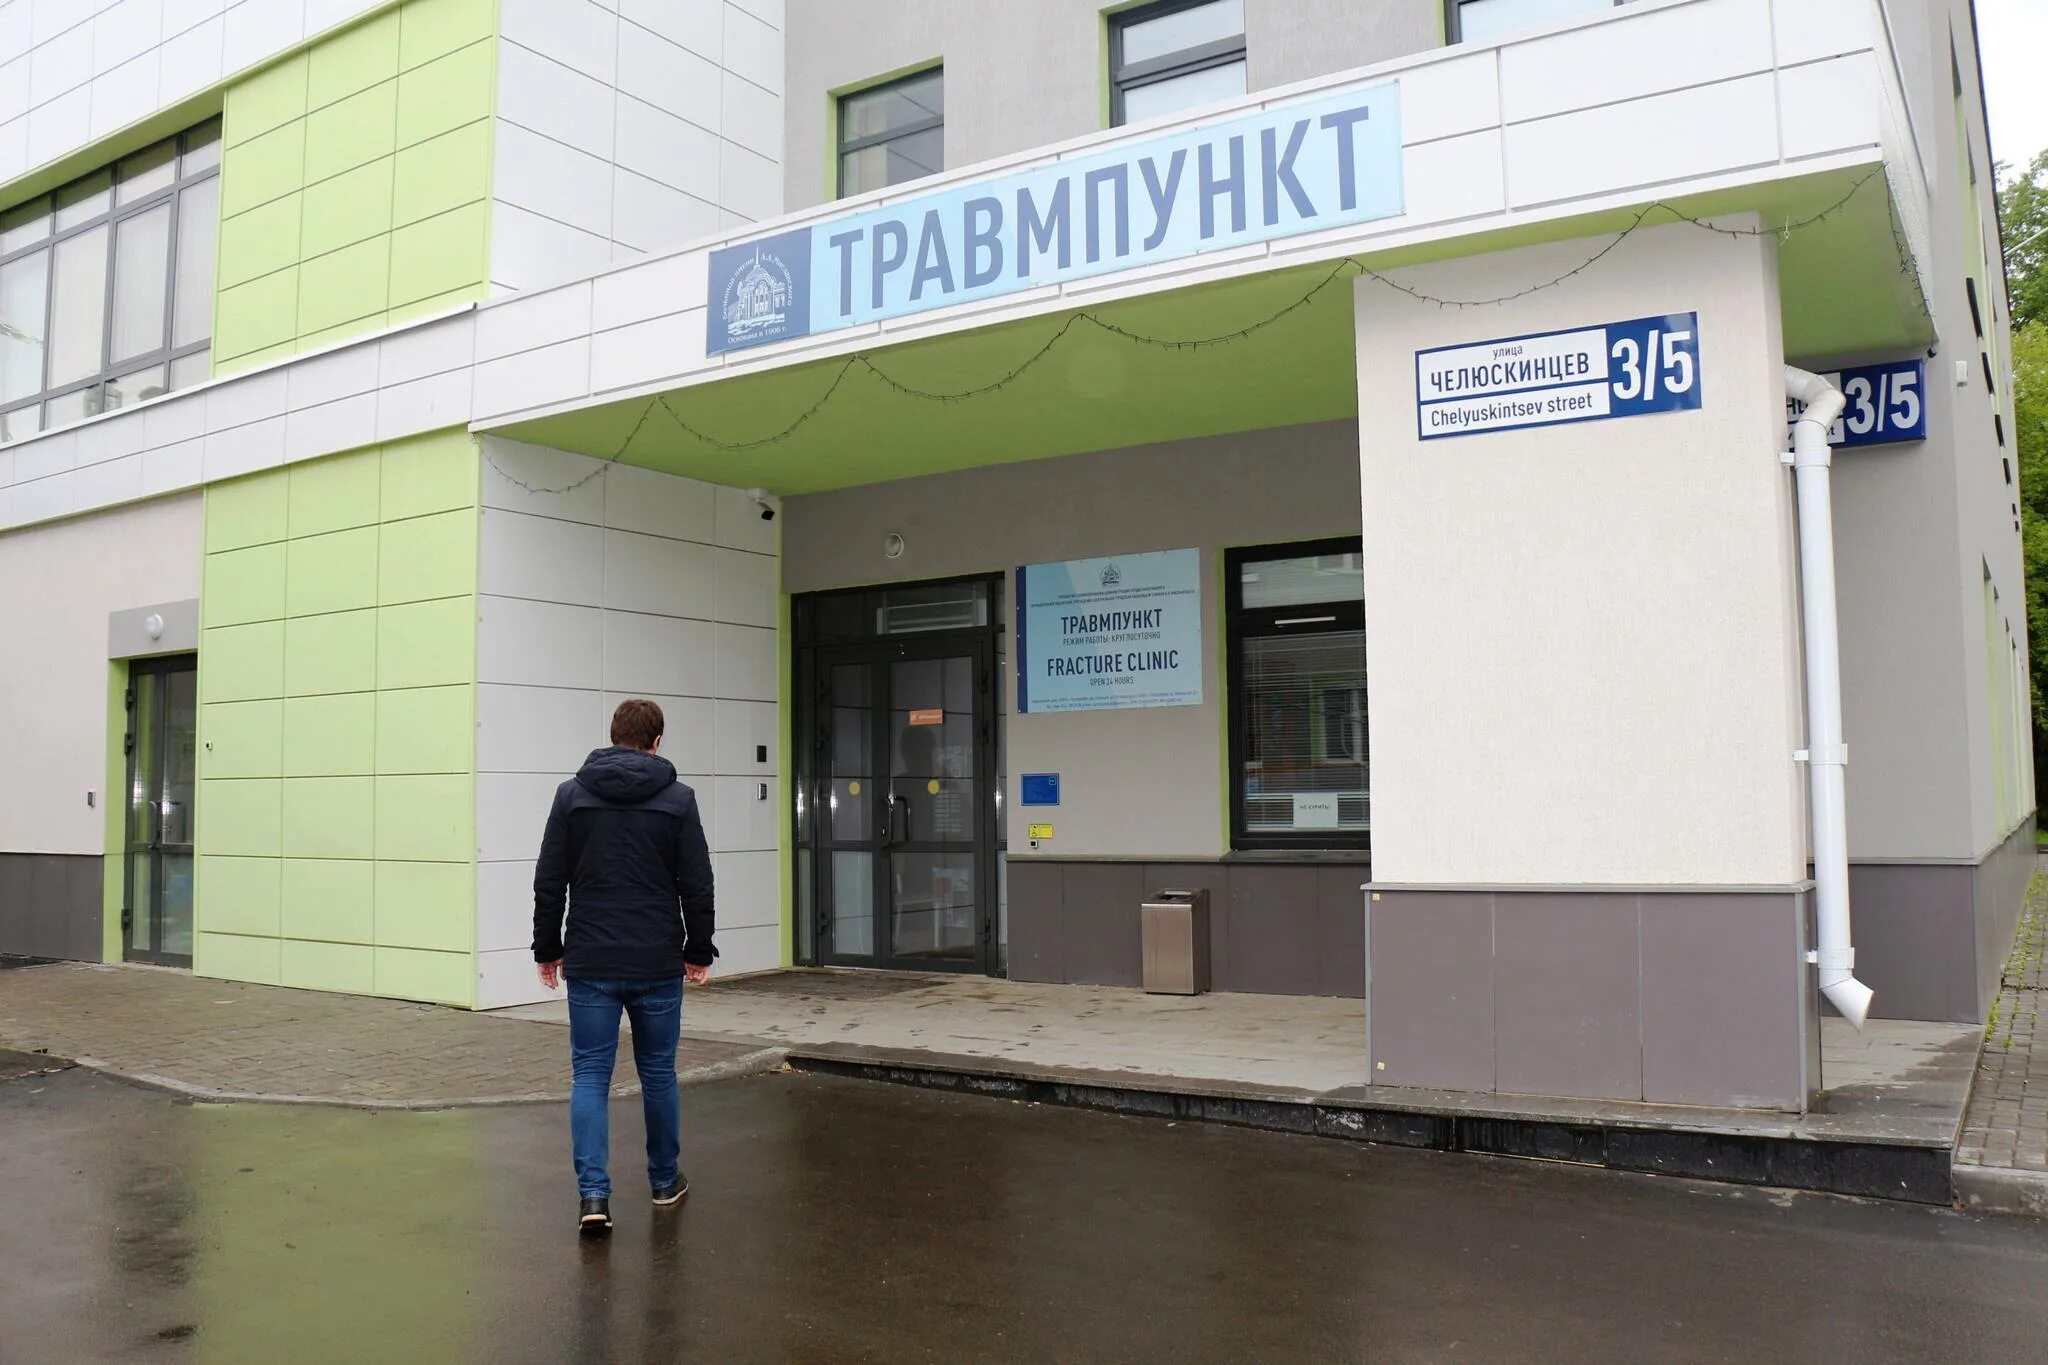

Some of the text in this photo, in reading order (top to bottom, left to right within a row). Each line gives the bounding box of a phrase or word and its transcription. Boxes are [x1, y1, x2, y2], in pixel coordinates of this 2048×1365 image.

[829, 106, 1369, 316] ТРАВМПУНКТ
[1493, 344, 1523, 361] улица
[1611, 329, 1694, 401] 3/5
[1431, 352, 1590, 393] ЧЕЛЮСКИНЦЕВ
[1431, 391, 1593, 427] Chelyuskintsev street
[1845, 371, 1920, 434] 3/5
[1061, 608, 1163, 635] ТРАВМПУНКТ
[1063, 637, 1085, 647] РЕЖИМ
[1111, 631, 1161, 643] КРУГЛОСУТОЧНО
[1047, 650, 1179, 677] FRACTURE CLINIC
[1090, 675, 1134, 687] OPEN 24 HOURS
